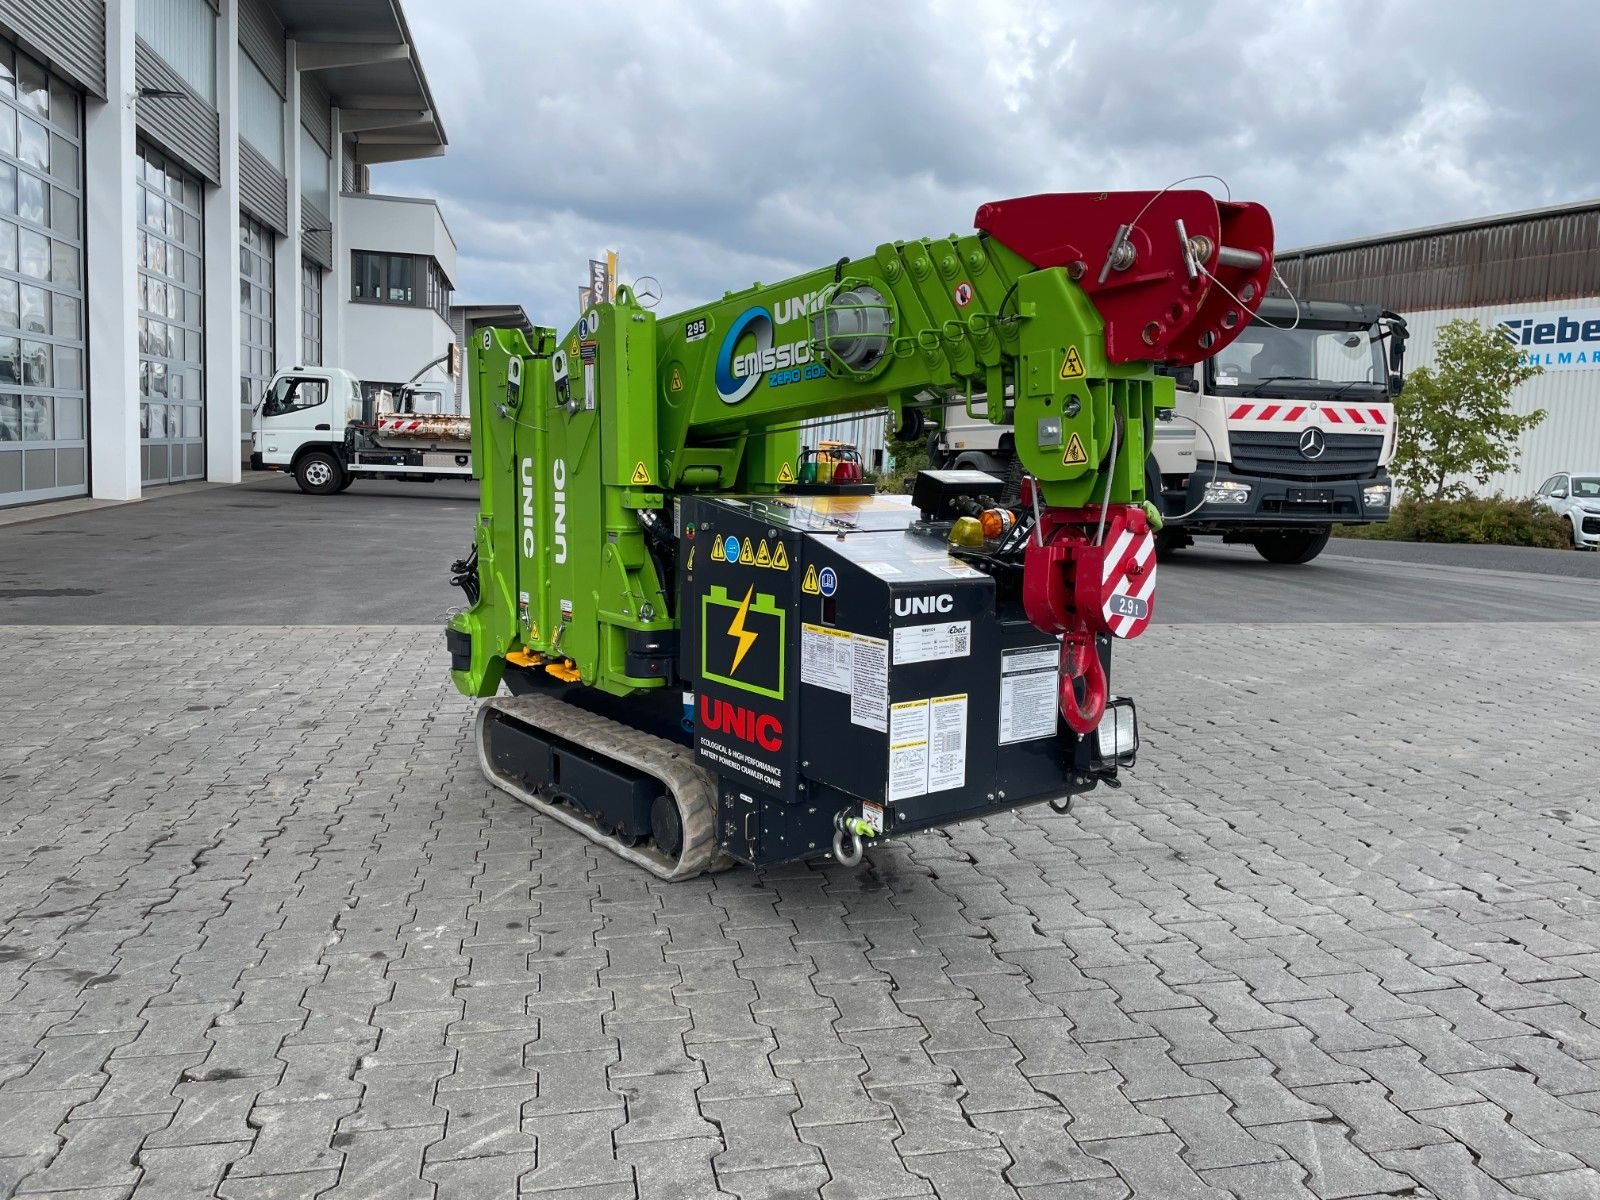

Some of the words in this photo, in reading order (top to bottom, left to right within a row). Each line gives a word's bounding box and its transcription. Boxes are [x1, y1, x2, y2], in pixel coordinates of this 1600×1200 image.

[484, 333, 490, 347] 2
[687, 320, 705, 336] 295
[768, 370, 801, 388] ZERO
[521, 457, 534, 559] UNIC
[553, 458, 567, 564] UNIC
[894, 593, 954, 617] UNIC
[1119, 598, 1134, 614] 2.9
[700, 694, 783, 752] UNIC
[700, 737, 728, 755] ECOLOGICAL
[732, 750, 745, 761] HIGH
[745, 755, 781, 777] PERFORMANCE
[700, 748, 718, 761] BATTERY
[719, 755, 741, 771] POWERED
[741, 765, 763, 781] CRAWLER
[763, 775, 781, 789] CRANE
